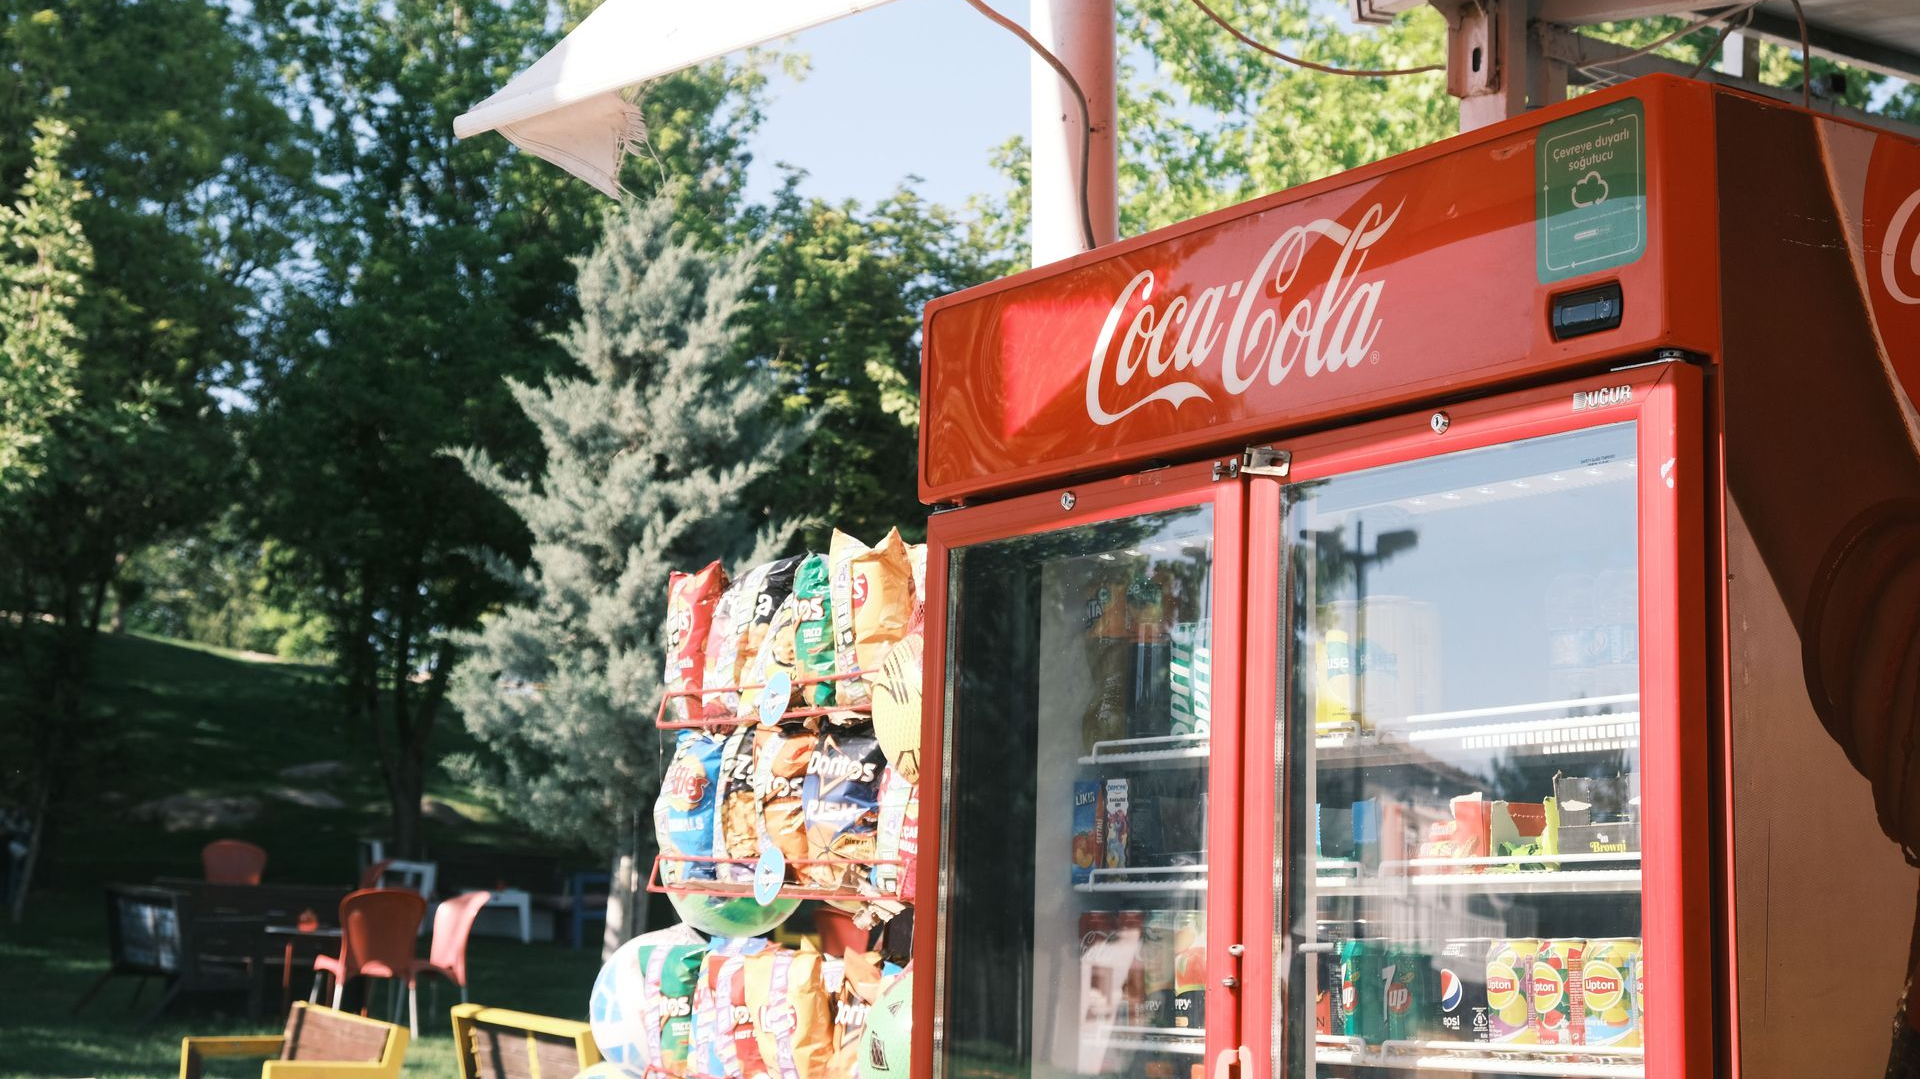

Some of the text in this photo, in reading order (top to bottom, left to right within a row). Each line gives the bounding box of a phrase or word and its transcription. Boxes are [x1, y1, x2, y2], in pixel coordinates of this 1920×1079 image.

[1553, 128, 1630, 163] Çevreye duyarlı
[1568, 151, 1614, 171] soğutucu
[1086, 194, 1407, 426] Coca-Cola
[807, 751, 877, 782] Doritos
[1590, 840, 1626, 854] Browni
[1585, 979, 1615, 992] Lipton
